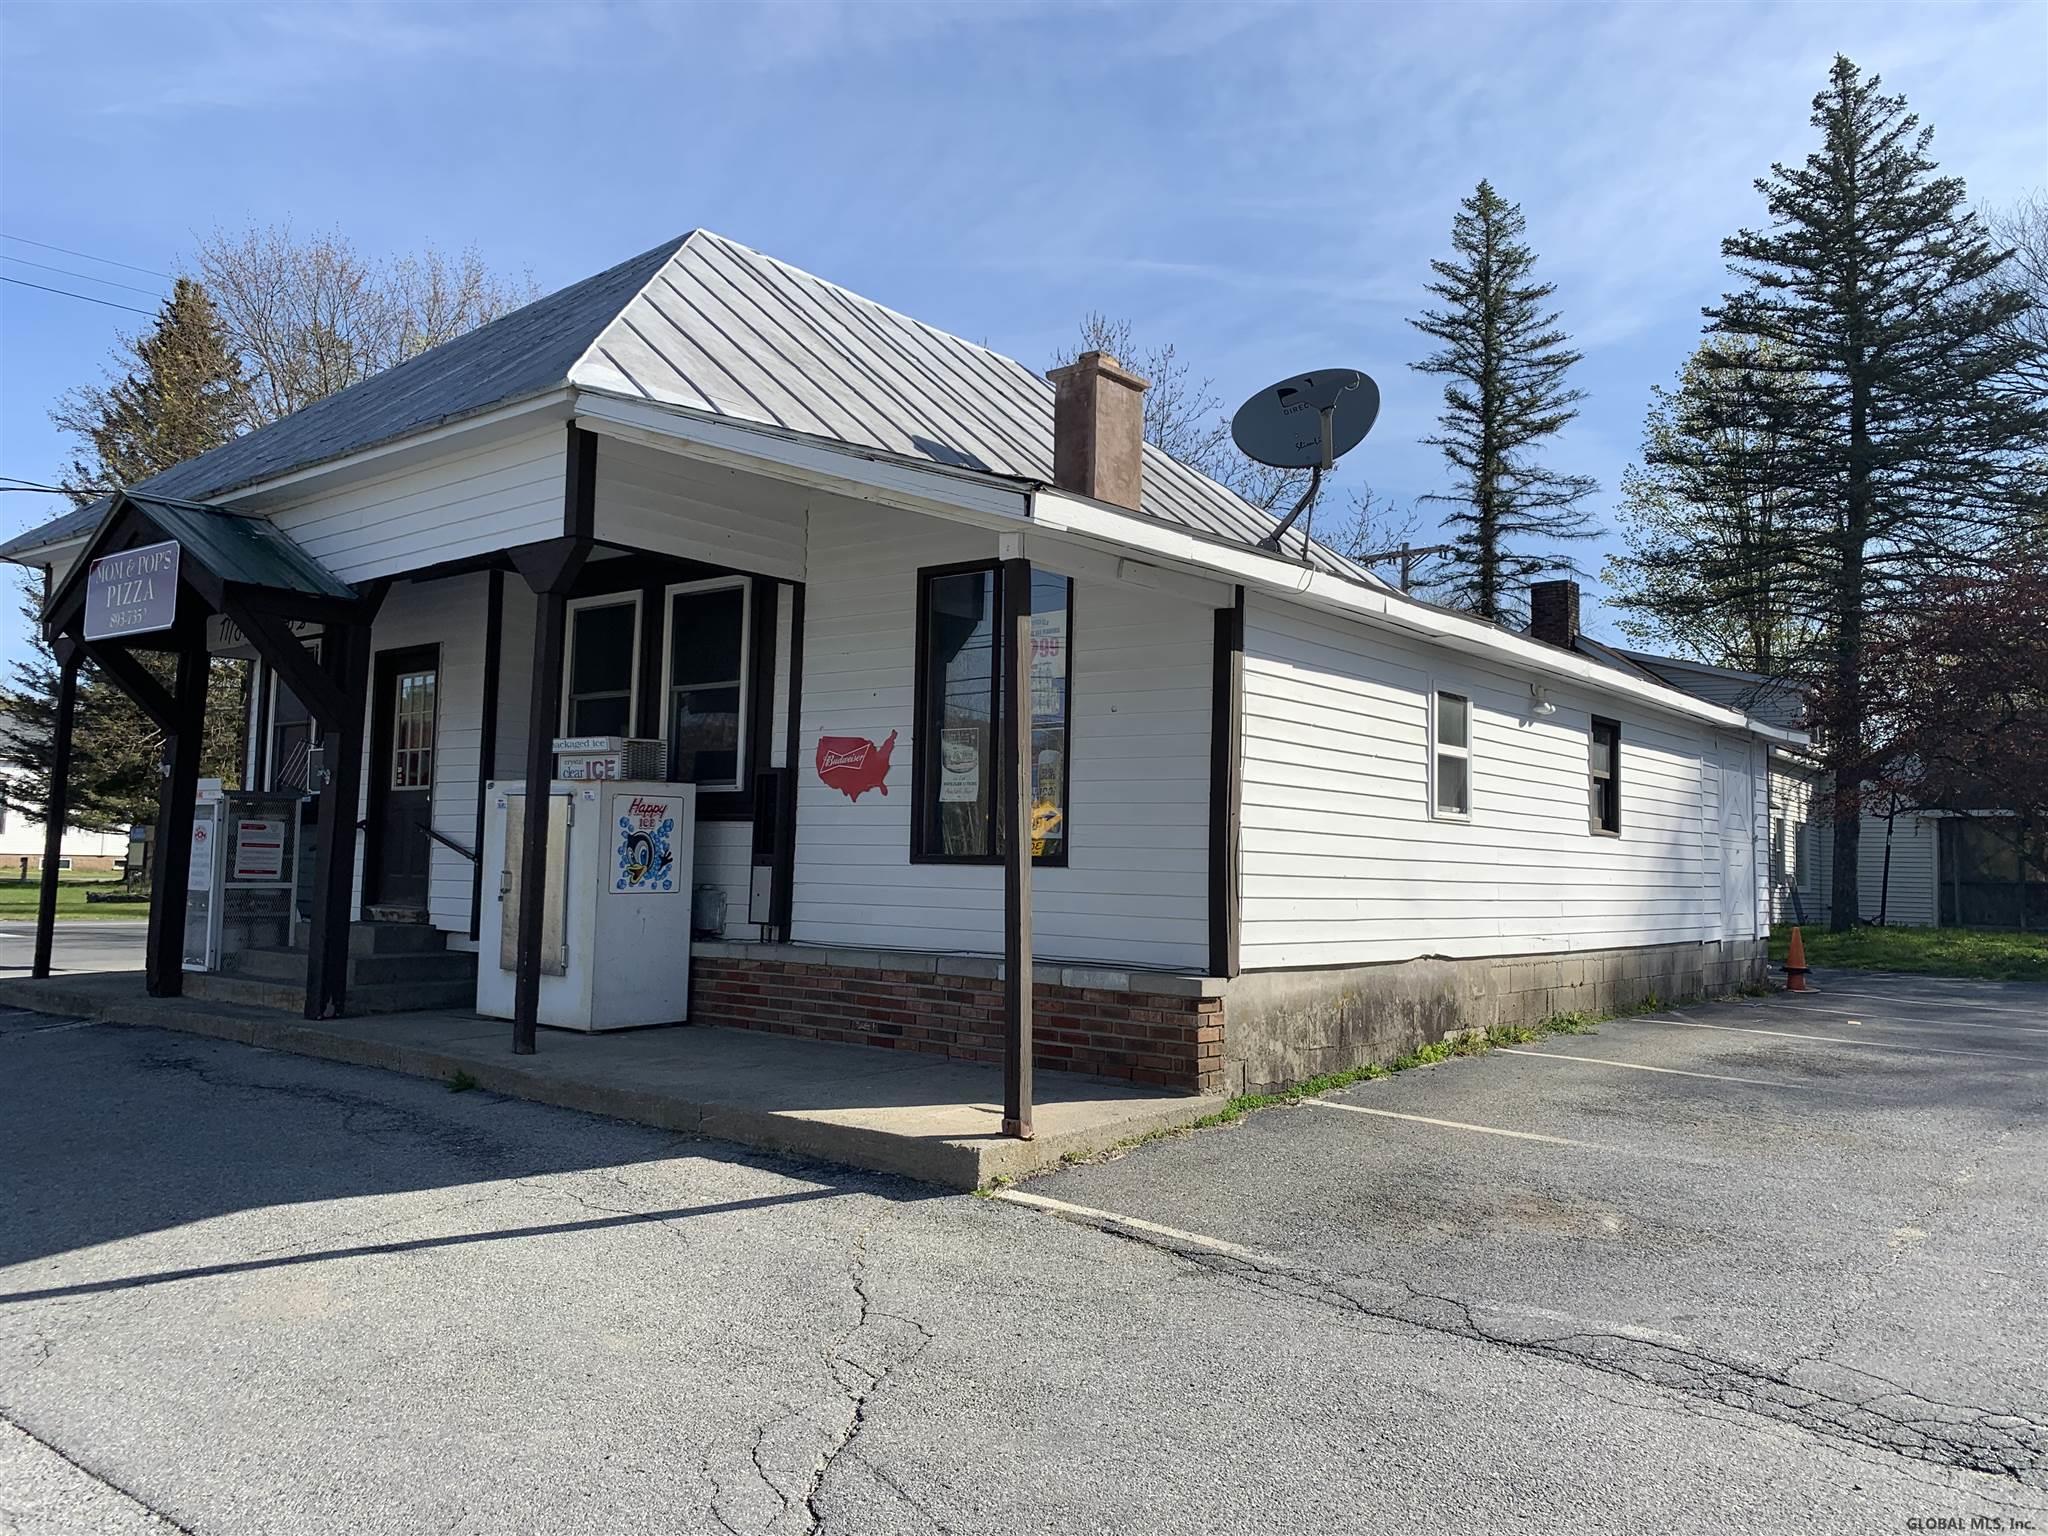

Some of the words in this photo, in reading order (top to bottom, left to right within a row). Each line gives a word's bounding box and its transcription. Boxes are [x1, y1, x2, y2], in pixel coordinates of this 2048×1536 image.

[96, 561, 124, 584] MOM
[126, 559, 136, 578] &
[138, 550, 172, 576] POP'S
[106, 578, 154, 608] PIZZA
[553, 739, 590, 750] ackaged
[562, 766, 584, 779] clear
[585, 759, 616, 780] ICE
[825, 754, 865, 767] Budweiser
[628, 797, 668, 819] Happy
[639, 818, 656, 828] ICE
